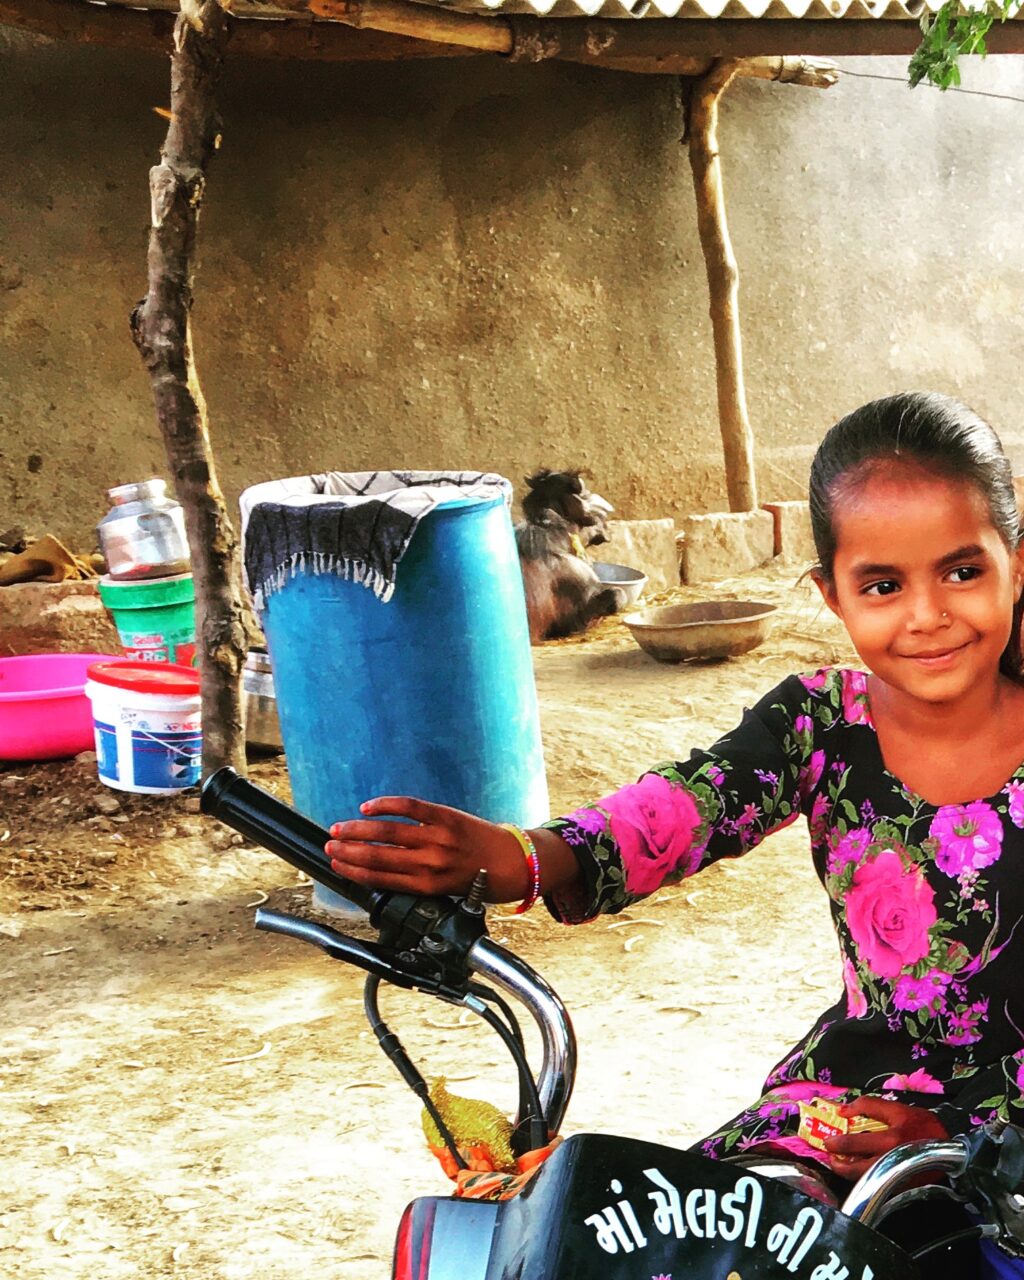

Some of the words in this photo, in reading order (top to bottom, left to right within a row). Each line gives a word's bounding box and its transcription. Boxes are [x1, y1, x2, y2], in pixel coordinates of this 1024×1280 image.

[584, 1179, 647, 1254] માં
[642, 1168, 763, 1248] મેલડી
[766, 1206, 823, 1273] ની
